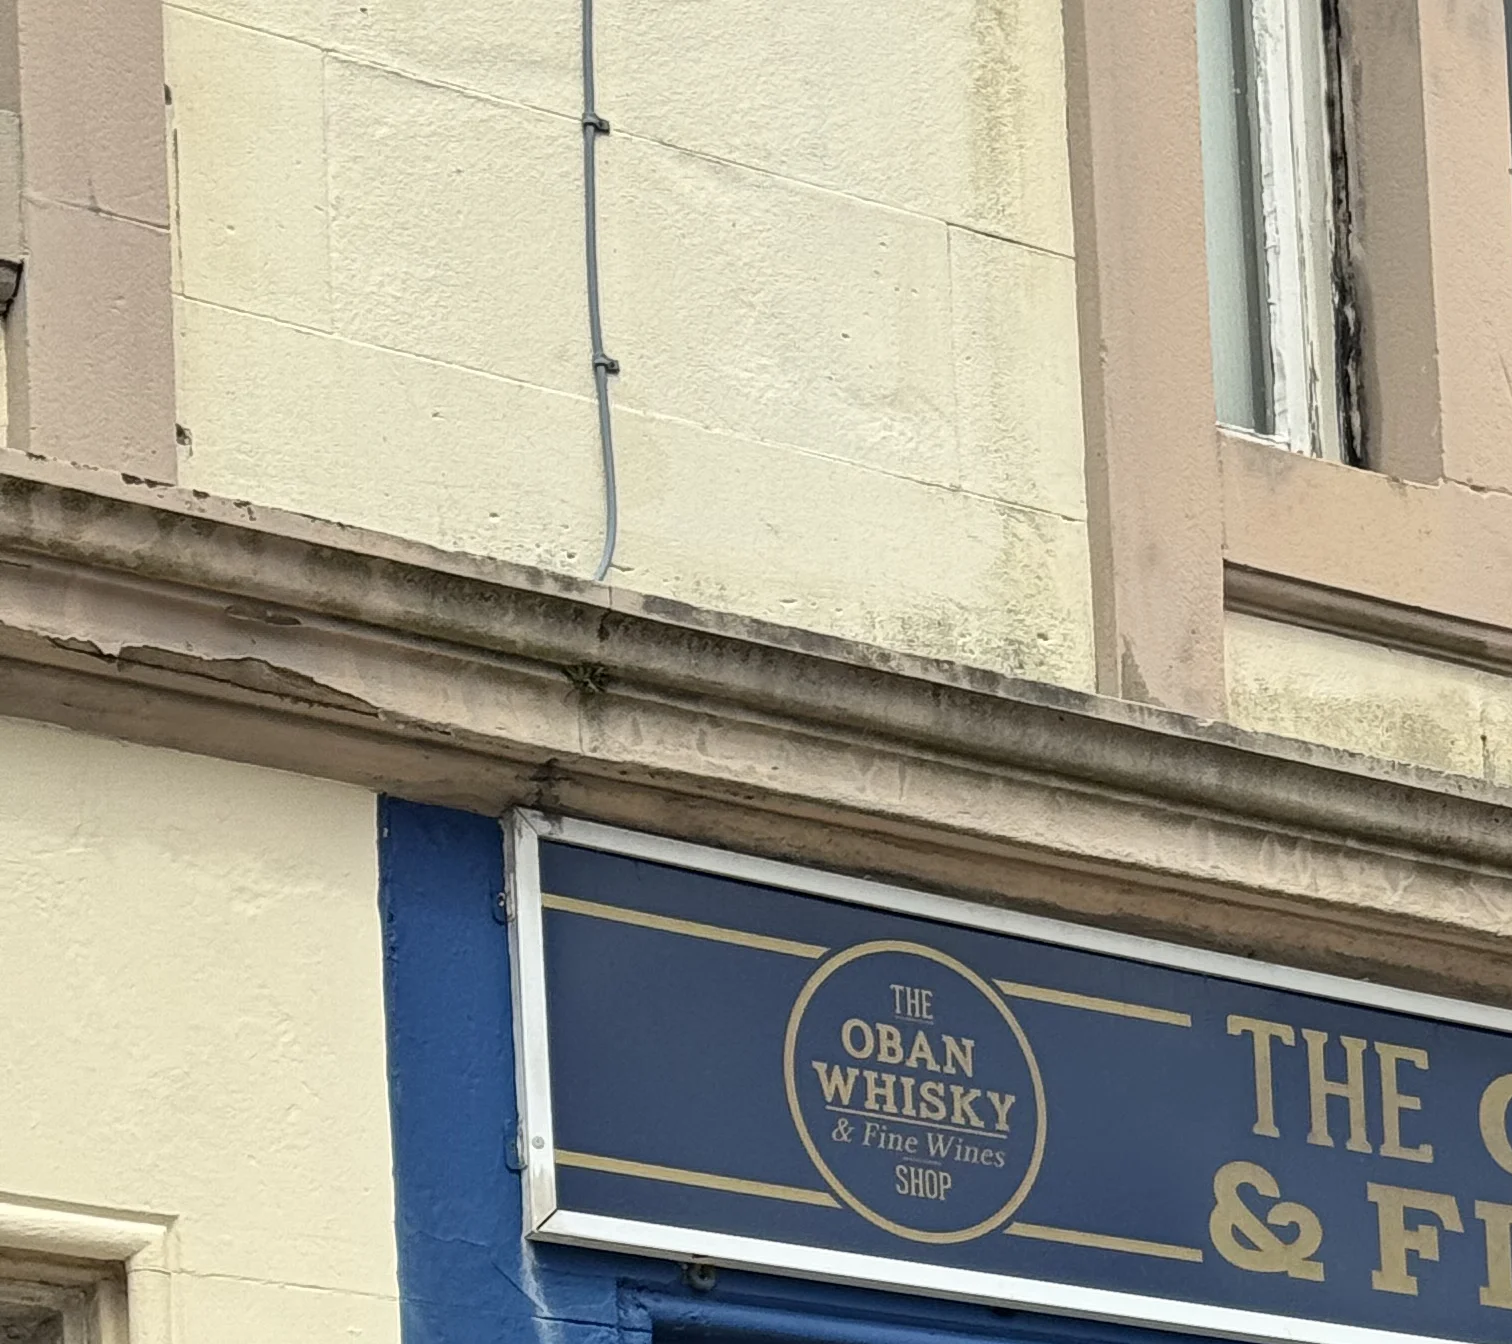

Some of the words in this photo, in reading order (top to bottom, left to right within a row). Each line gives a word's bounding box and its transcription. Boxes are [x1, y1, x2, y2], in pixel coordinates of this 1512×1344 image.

[890, 984, 934, 1020] THE
[841, 1017, 975, 1078] OBAN
[811, 1060, 1016, 1132] WHISKY
[1226, 1013, 1434, 1164] THE
[831, 1117, 855, 1144] &
[862, 1122, 919, 1154] Fine
[927, 1131, 1006, 1169] Wines
[895, 1164, 952, 1201] SHOP
[1208, 1160, 1325, 1282] &
